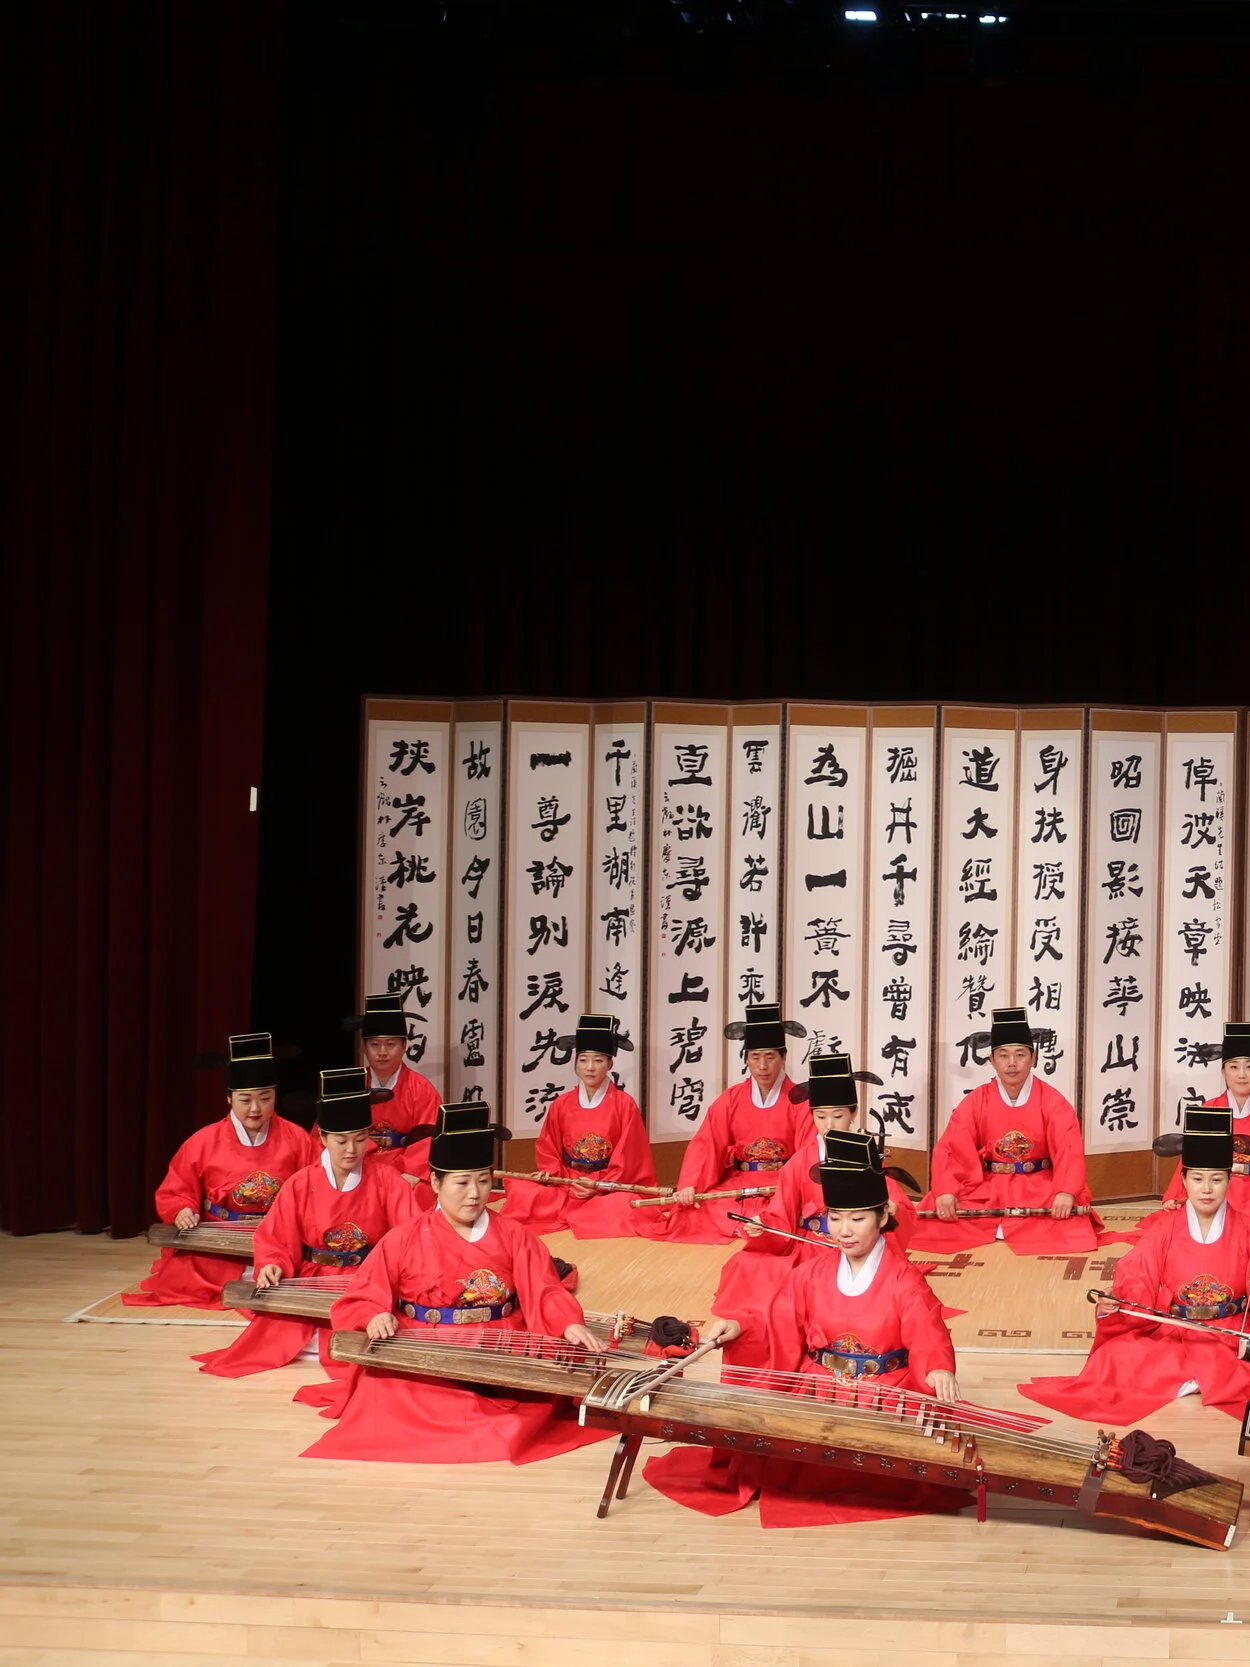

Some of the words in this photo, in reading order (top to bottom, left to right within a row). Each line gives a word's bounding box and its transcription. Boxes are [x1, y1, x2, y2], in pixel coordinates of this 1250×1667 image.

[599, 740, 631, 1090] 千里湖南逢
[738, 740, 771, 1075] 雲衢若許乘
[954, 746, 1001, 1112] 道大經綸贊化
